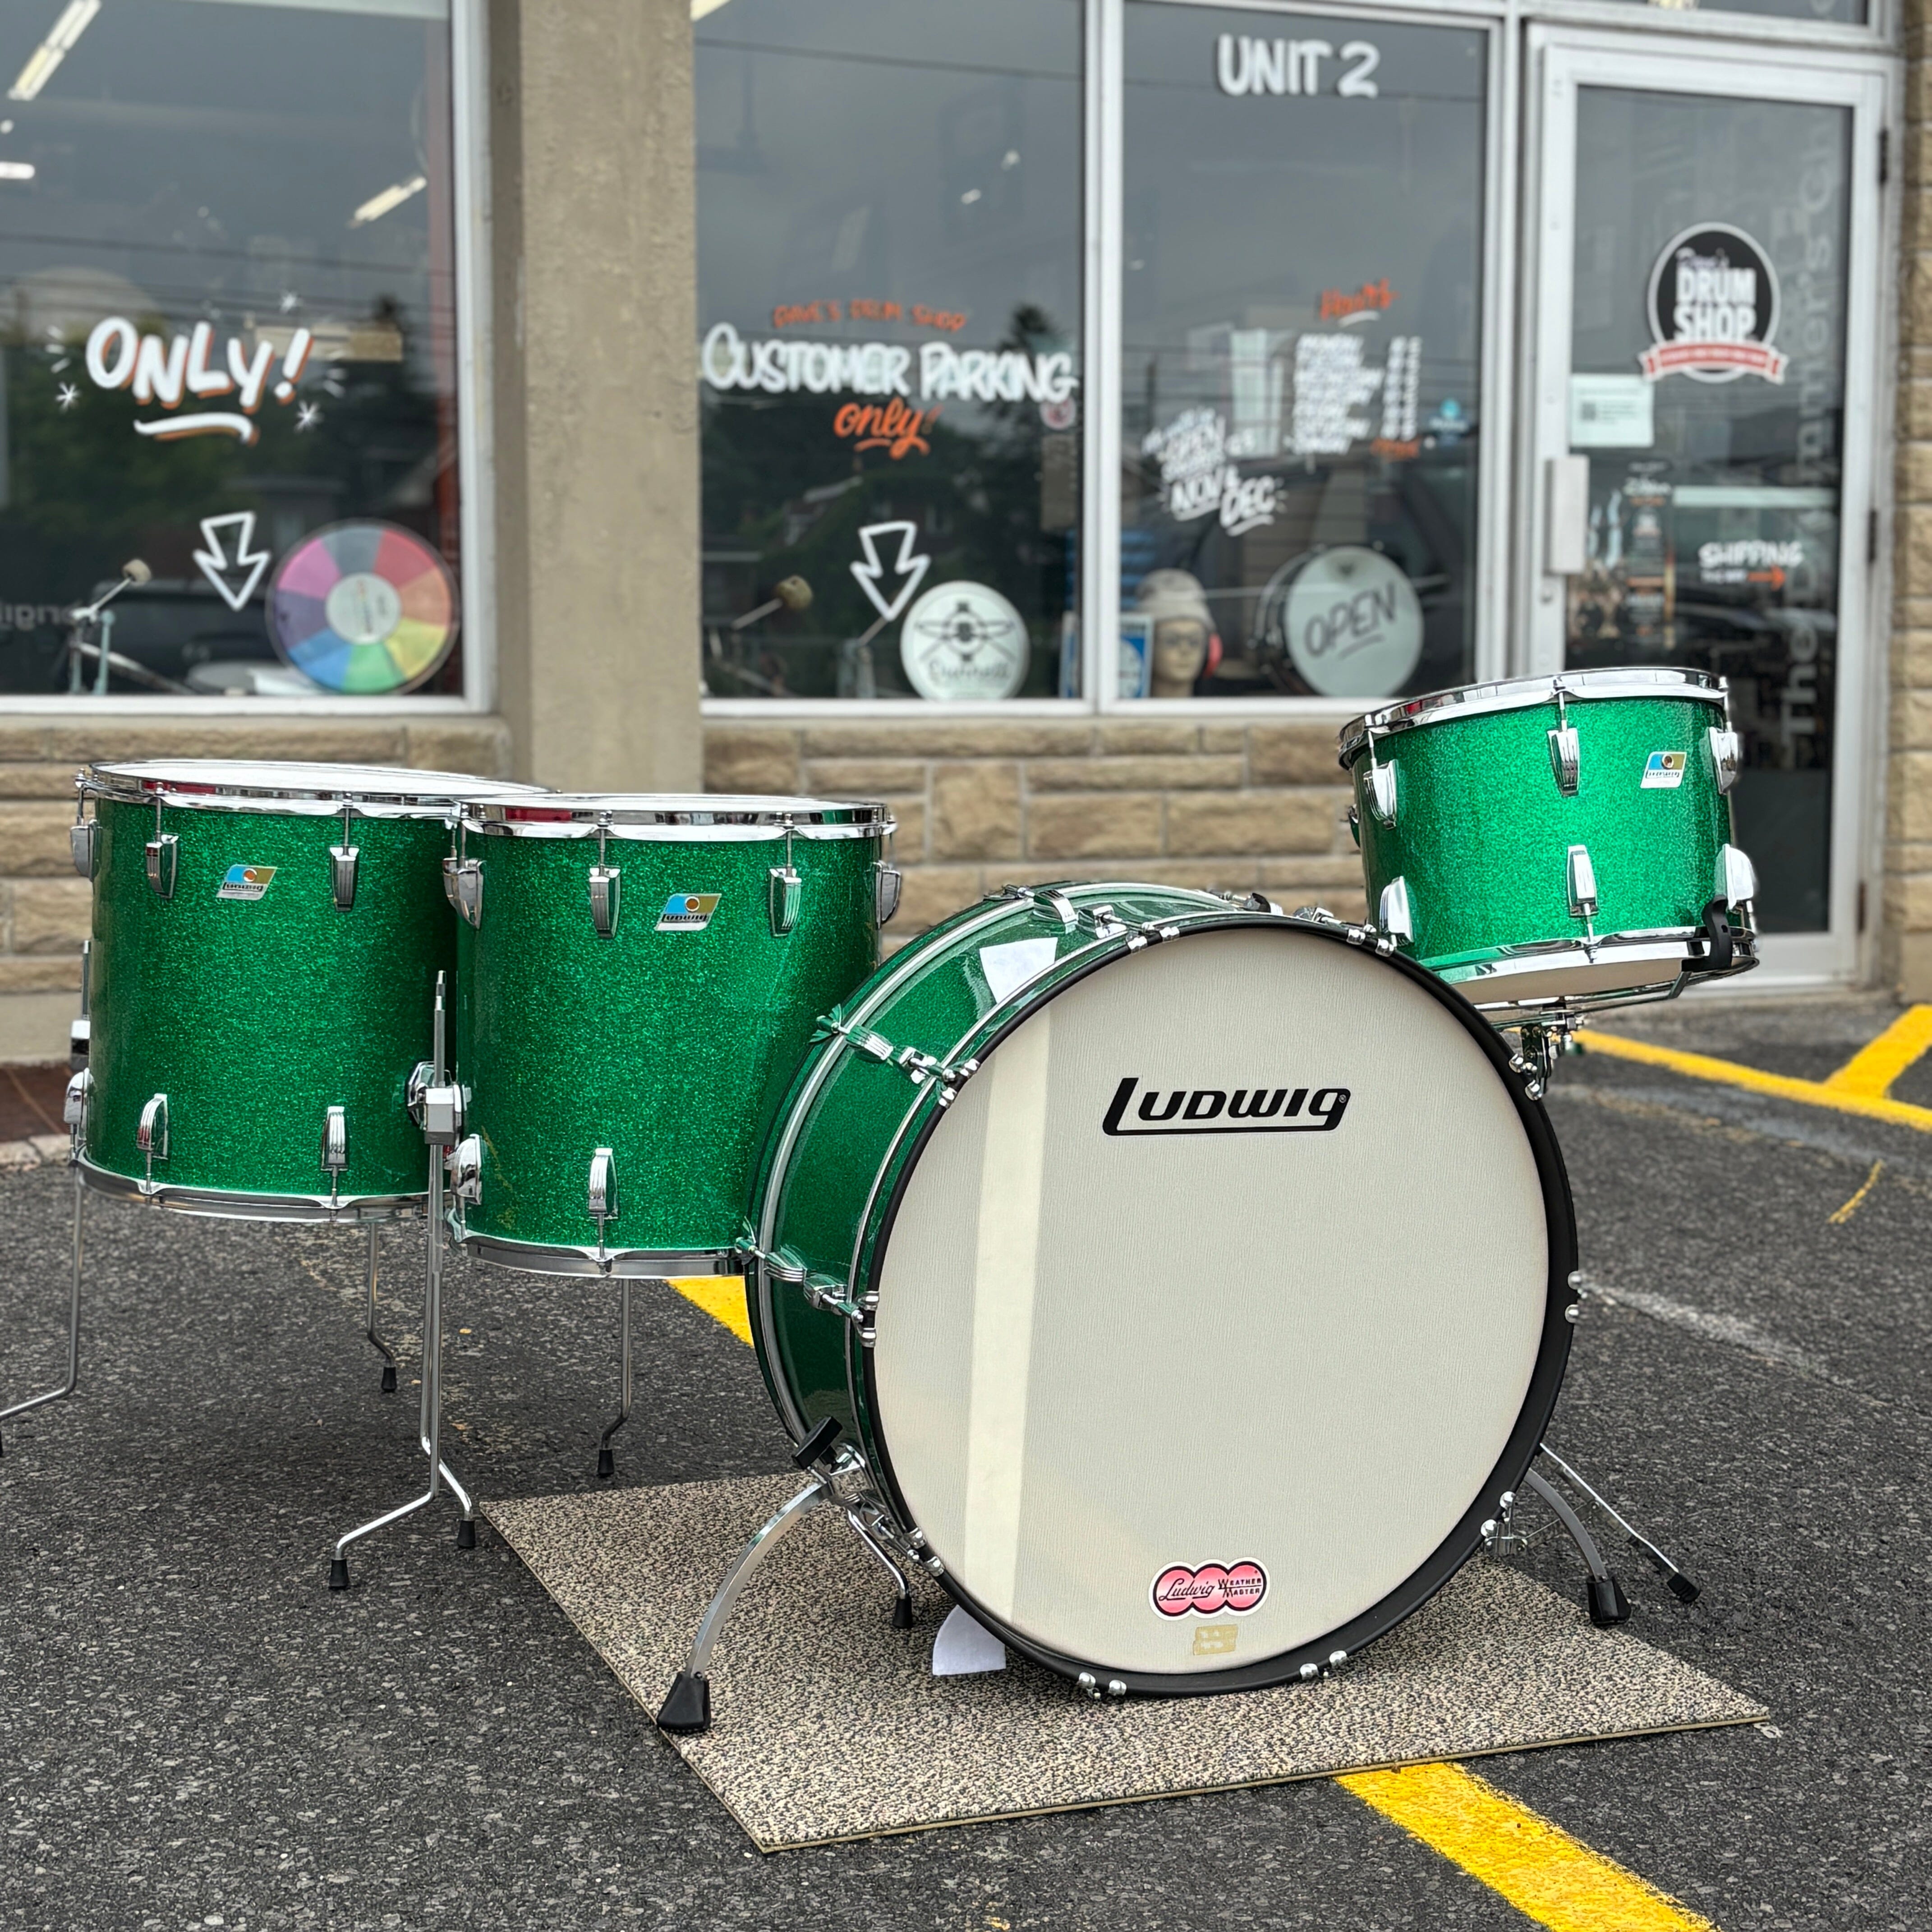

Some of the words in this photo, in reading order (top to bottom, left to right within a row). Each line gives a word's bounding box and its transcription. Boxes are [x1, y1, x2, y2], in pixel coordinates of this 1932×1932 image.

[1219, 34, 1332, 96] UNIT
[1338, 41, 1380, 98] 2
[1676, 268, 1756, 303] DRUM
[1674, 303, 1756, 345] SHOP
[86, 317, 314, 413] ONLY!
[702, 322, 910, 394] CUSTOMER
[919, 342, 1080, 402] PARKING
[1306, 584, 1396, 657] OPEN
[1103, 1077, 1351, 1136] Ludwig
[1159, 1578, 1215, 1601] Ludwig
[1218, 1578, 1261, 1589] WEATHER
[1223, 1587, 1260, 1598] MASTER
